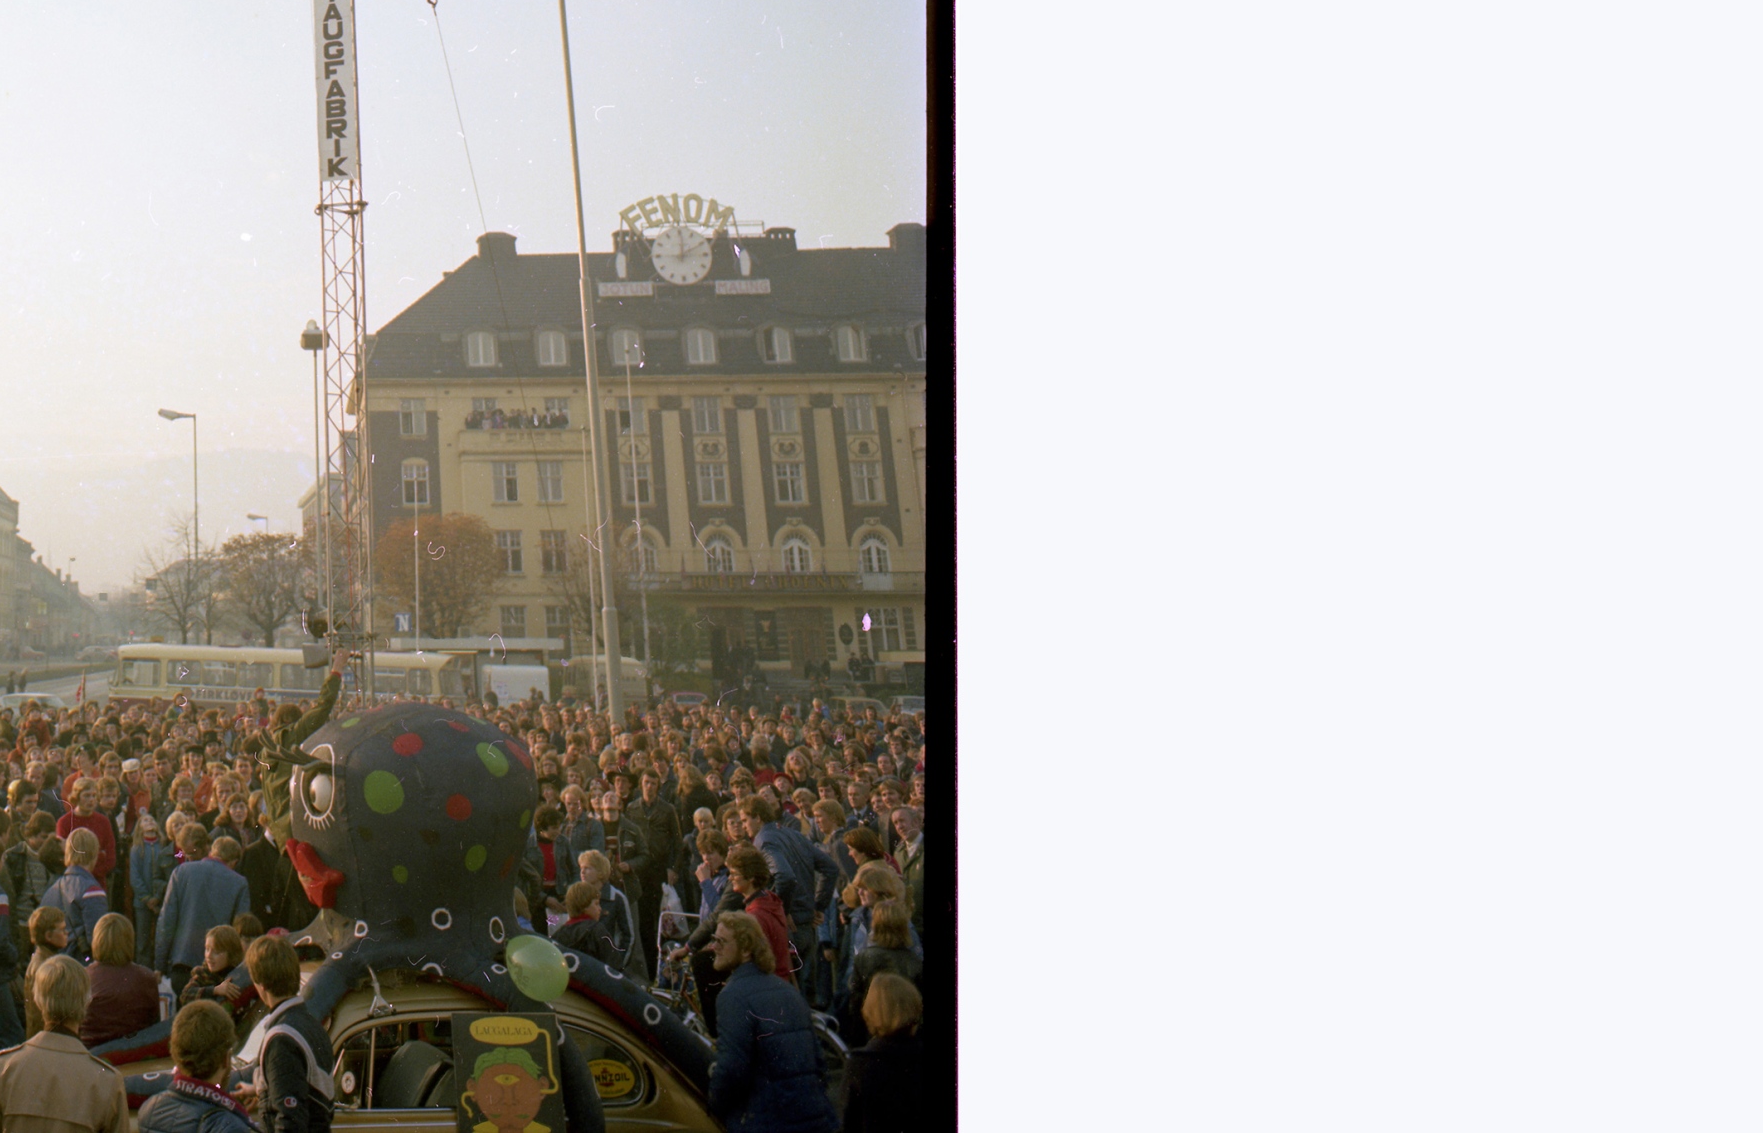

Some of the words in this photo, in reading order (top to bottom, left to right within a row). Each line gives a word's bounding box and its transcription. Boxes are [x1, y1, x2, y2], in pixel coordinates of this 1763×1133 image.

[619, 192, 735, 237] FENOM
[717, 280, 768, 293] MALING
[692, 575, 750, 589] HOTEL
